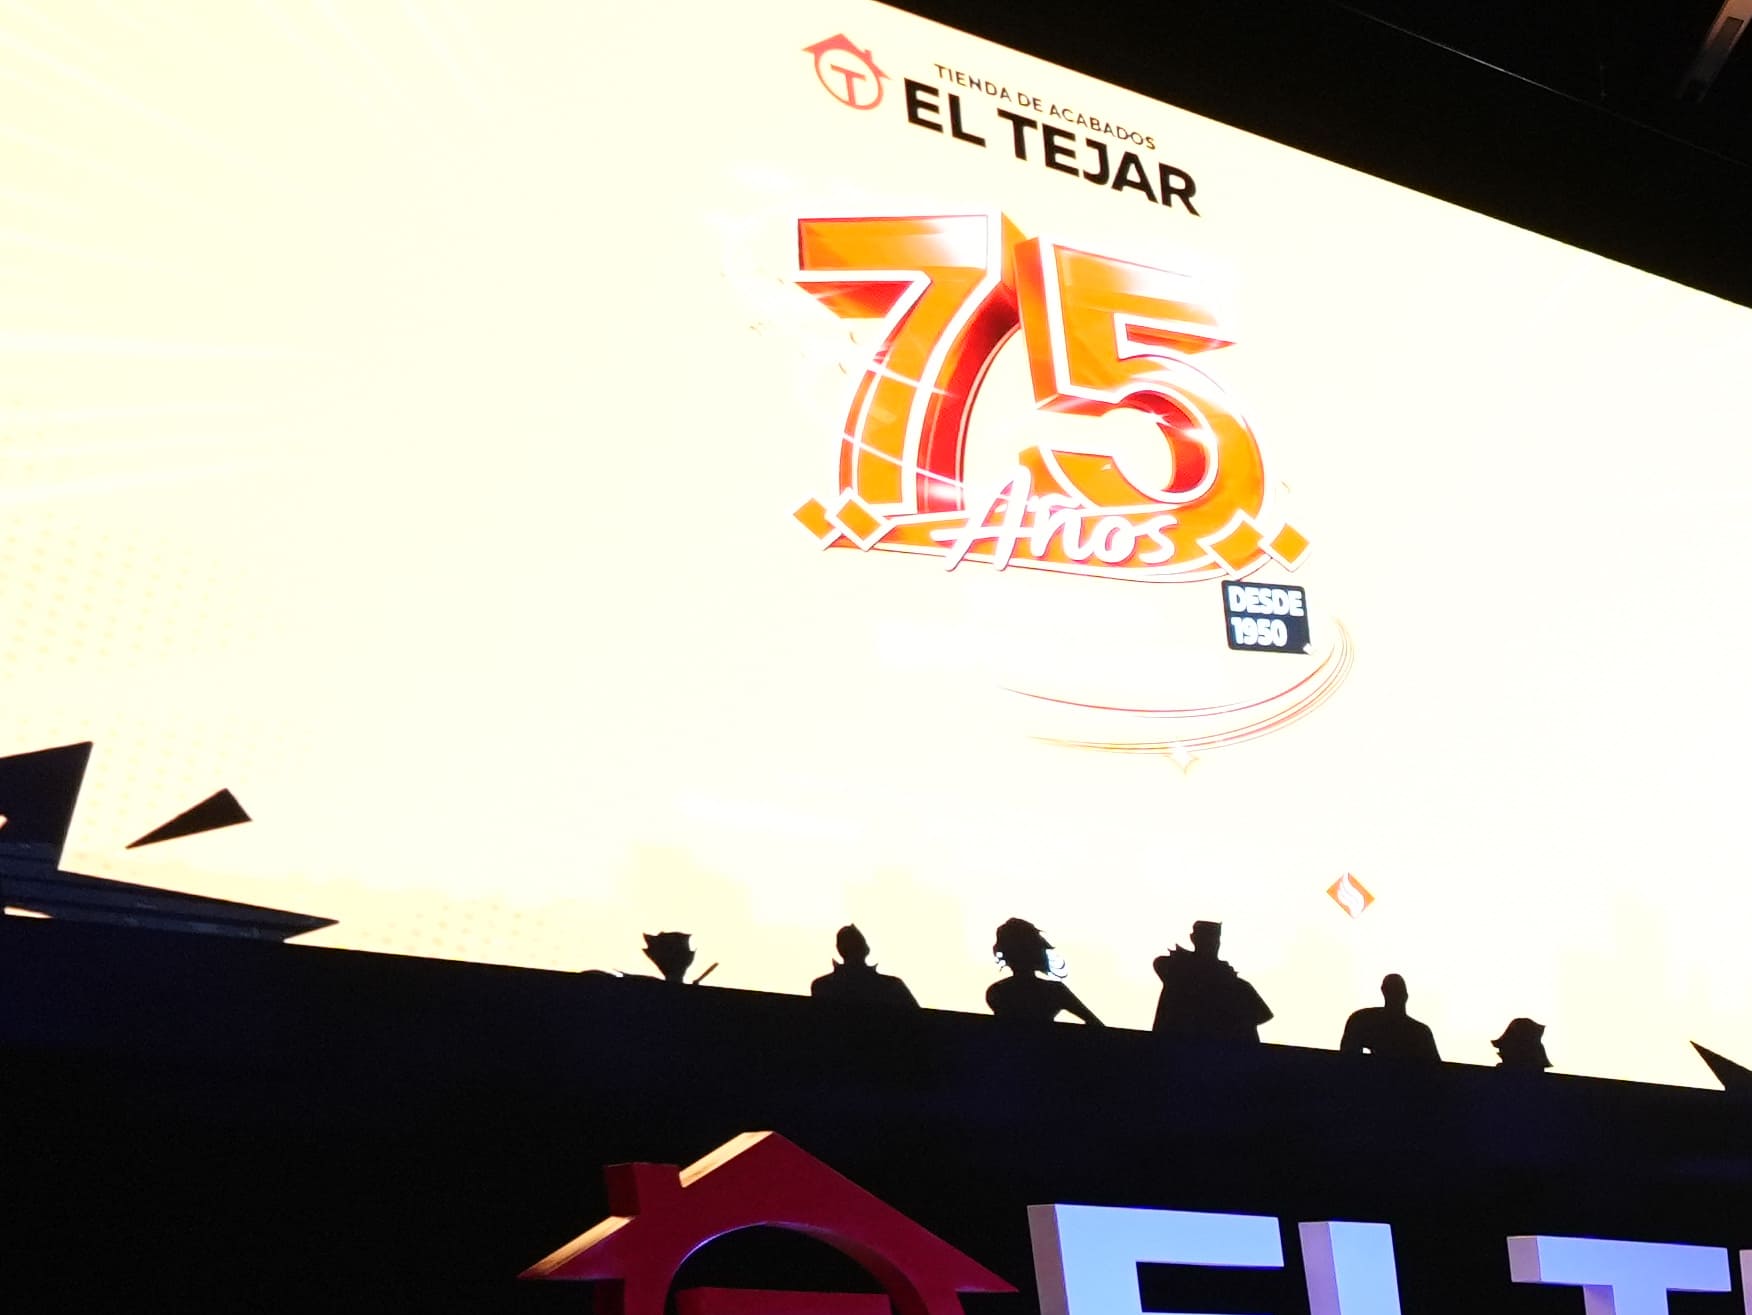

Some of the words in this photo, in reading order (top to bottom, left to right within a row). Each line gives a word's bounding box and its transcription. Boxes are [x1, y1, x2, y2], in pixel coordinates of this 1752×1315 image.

[903, 77, 986, 148] EL
[997, 107, 1201, 218] TEJAR
[933, 63, 1011, 102] TIENDA
[1017, 92, 1044, 112] DE
[1049, 103, 1156, 151] ACABADOS
[795, 212, 1264, 530] 75
[1228, 584, 1304, 619] DESDE
[1231, 616, 1288, 648] 1950
